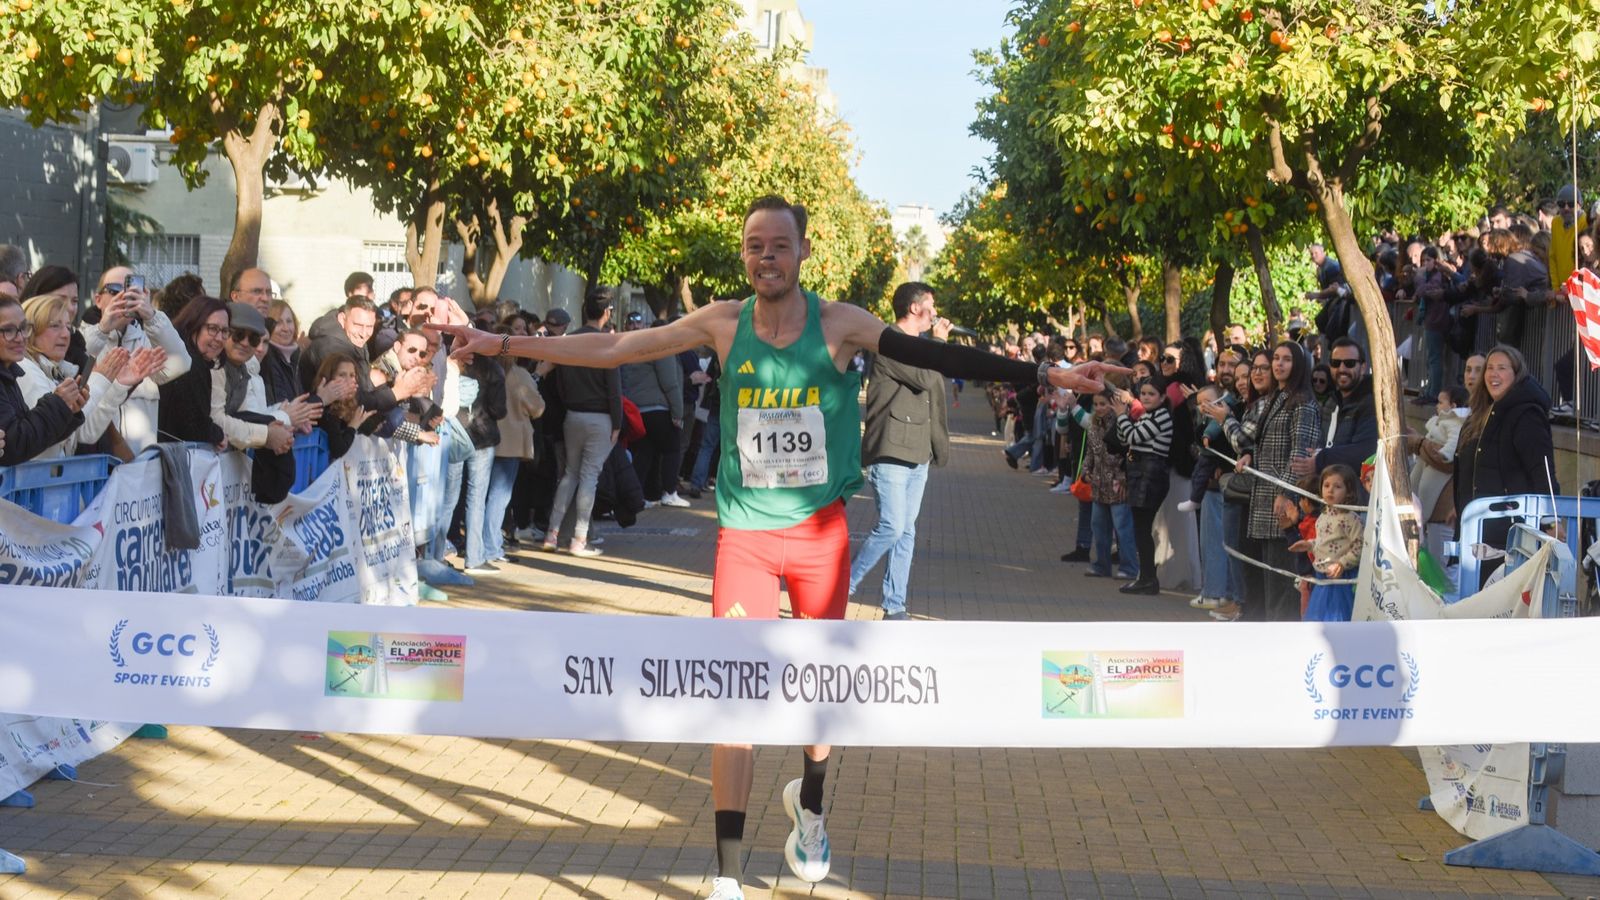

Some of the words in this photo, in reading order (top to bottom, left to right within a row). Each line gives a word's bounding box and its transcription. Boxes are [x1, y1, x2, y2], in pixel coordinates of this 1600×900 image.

[737, 386, 820, 409] BIKILA
[752, 431, 812, 454] 1139
[132, 632, 196, 656] GCC
[390, 647, 405, 656] EL
[408, 648, 462, 659] PARQUE
[391, 640, 432, 648] Asociación
[434, 641, 462, 649] Vecinal
[114, 672, 158, 685] SPORT
[160, 675, 211, 688] EVENTS
[563, 655, 614, 696] SAN
[640, 657, 770, 700] SILVESTRE
[781, 663, 939, 705] CORDOBESA
[1107, 665, 1122, 674] EL
[1126, 665, 1180, 676] PARQUE
[1329, 664, 1396, 688] GCC
[1313, 708, 1359, 720] SPORT
[1362, 707, 1414, 720] EVENTS
